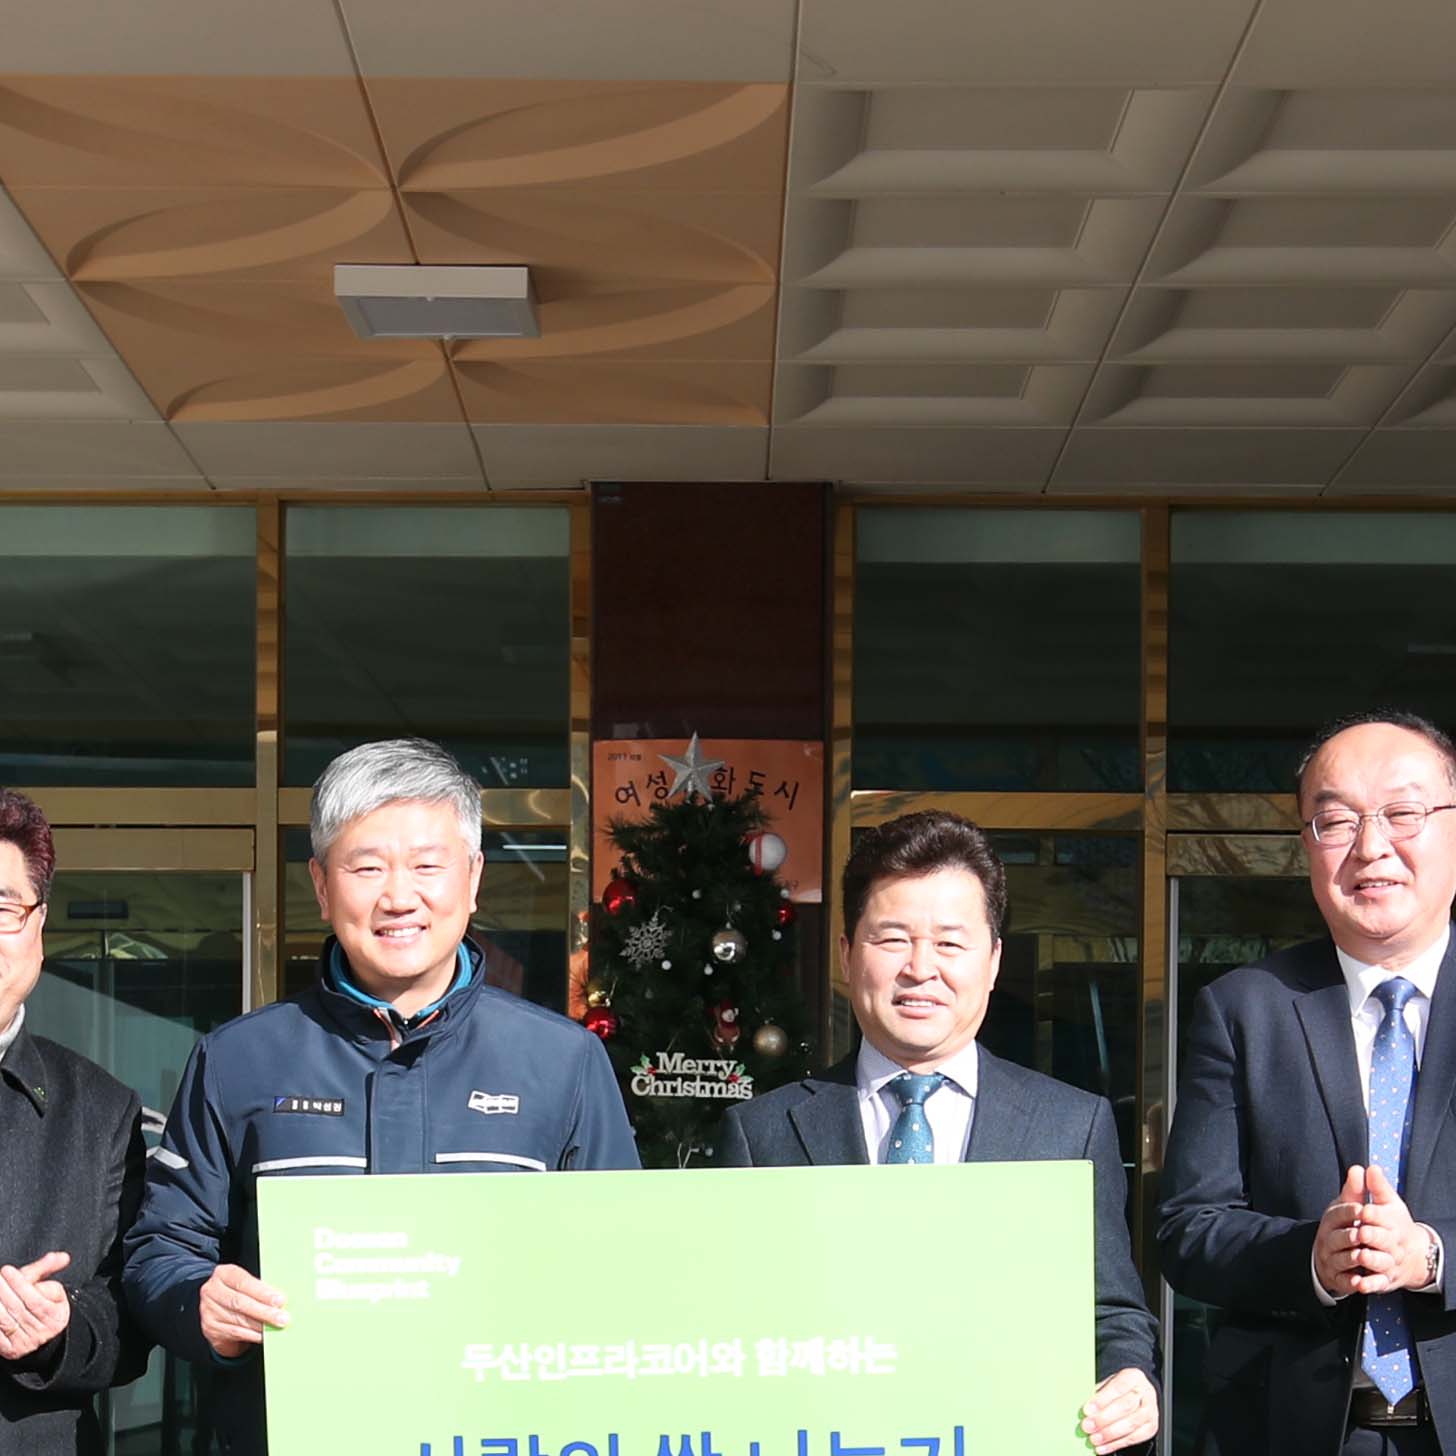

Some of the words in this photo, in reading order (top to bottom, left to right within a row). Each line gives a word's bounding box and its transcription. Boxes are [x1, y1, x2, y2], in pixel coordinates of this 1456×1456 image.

[655, 1051, 737, 1080] Merry
[630, 1072, 754, 1101] Christmas
[460, 1337, 744, 1384] 두산인프라코어와
[756, 1335, 899, 1380] 함께하는
